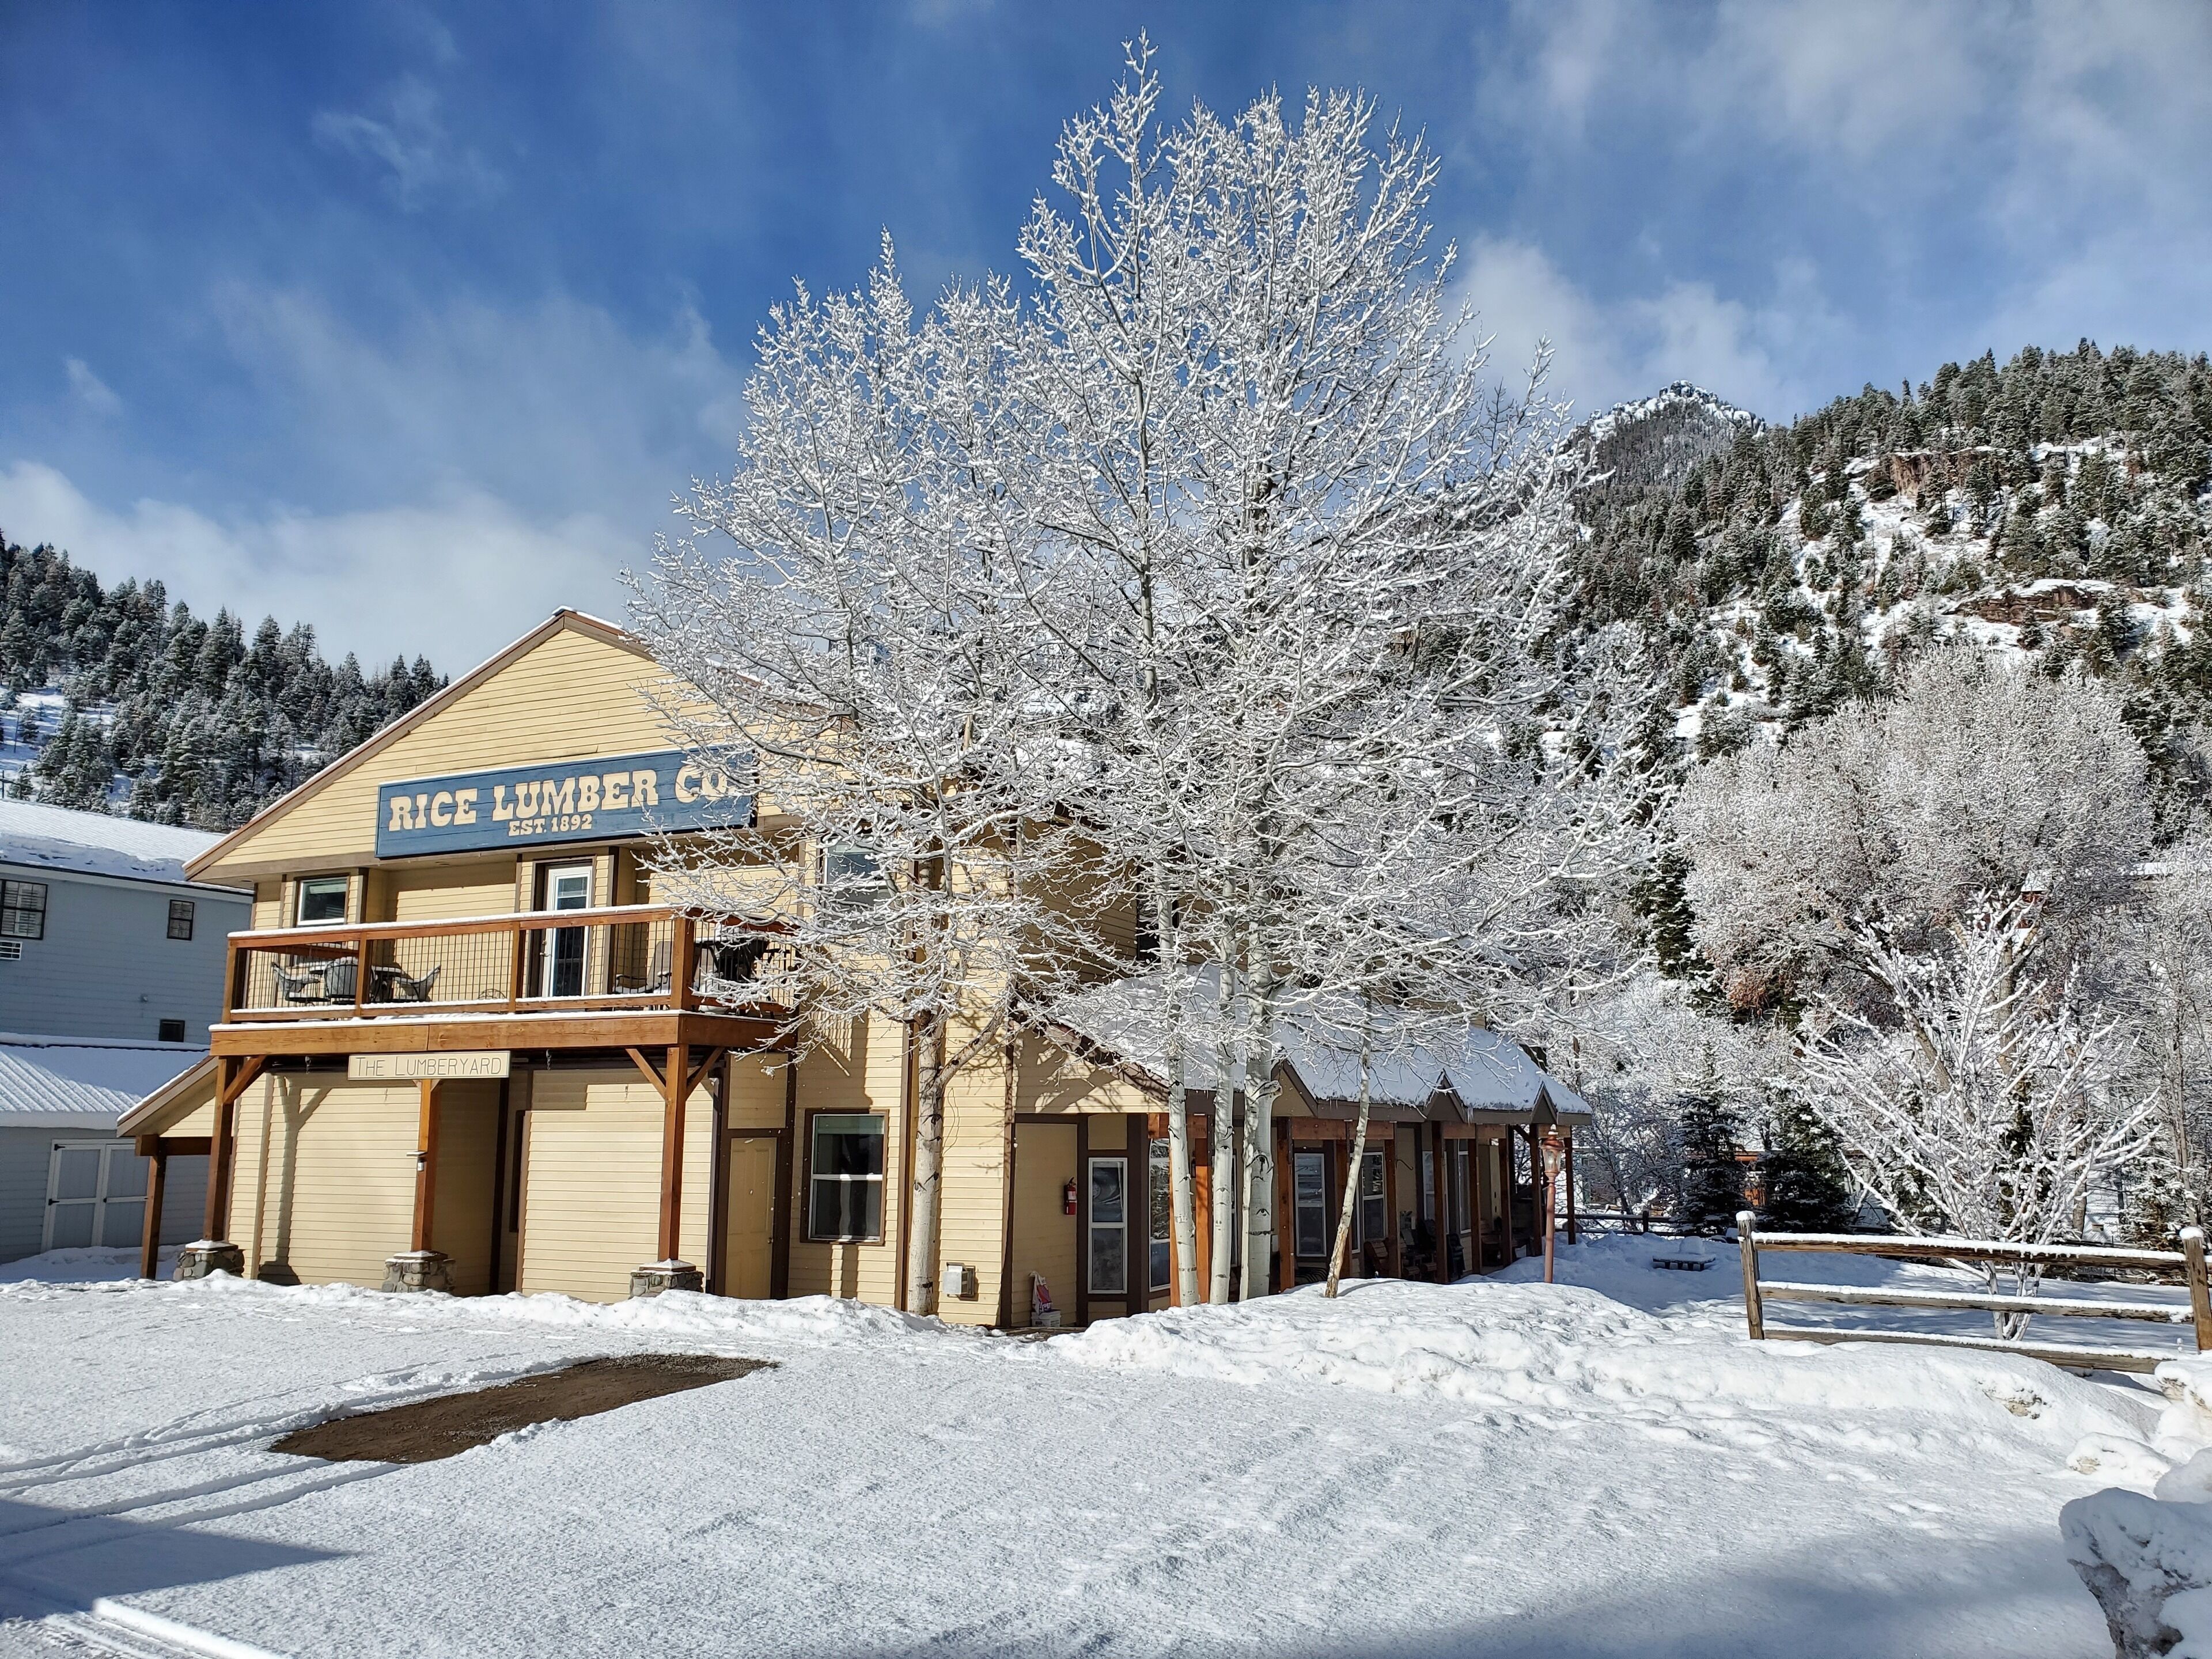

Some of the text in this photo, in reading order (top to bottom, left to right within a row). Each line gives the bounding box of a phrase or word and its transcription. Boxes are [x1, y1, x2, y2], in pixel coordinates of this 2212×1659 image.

[389, 788, 478, 831] RICE
[492, 770, 658, 821] LUMBER
[509, 813, 592, 836] EST. 1892
[356, 1056, 502, 1076] THE LUMBERYARD
